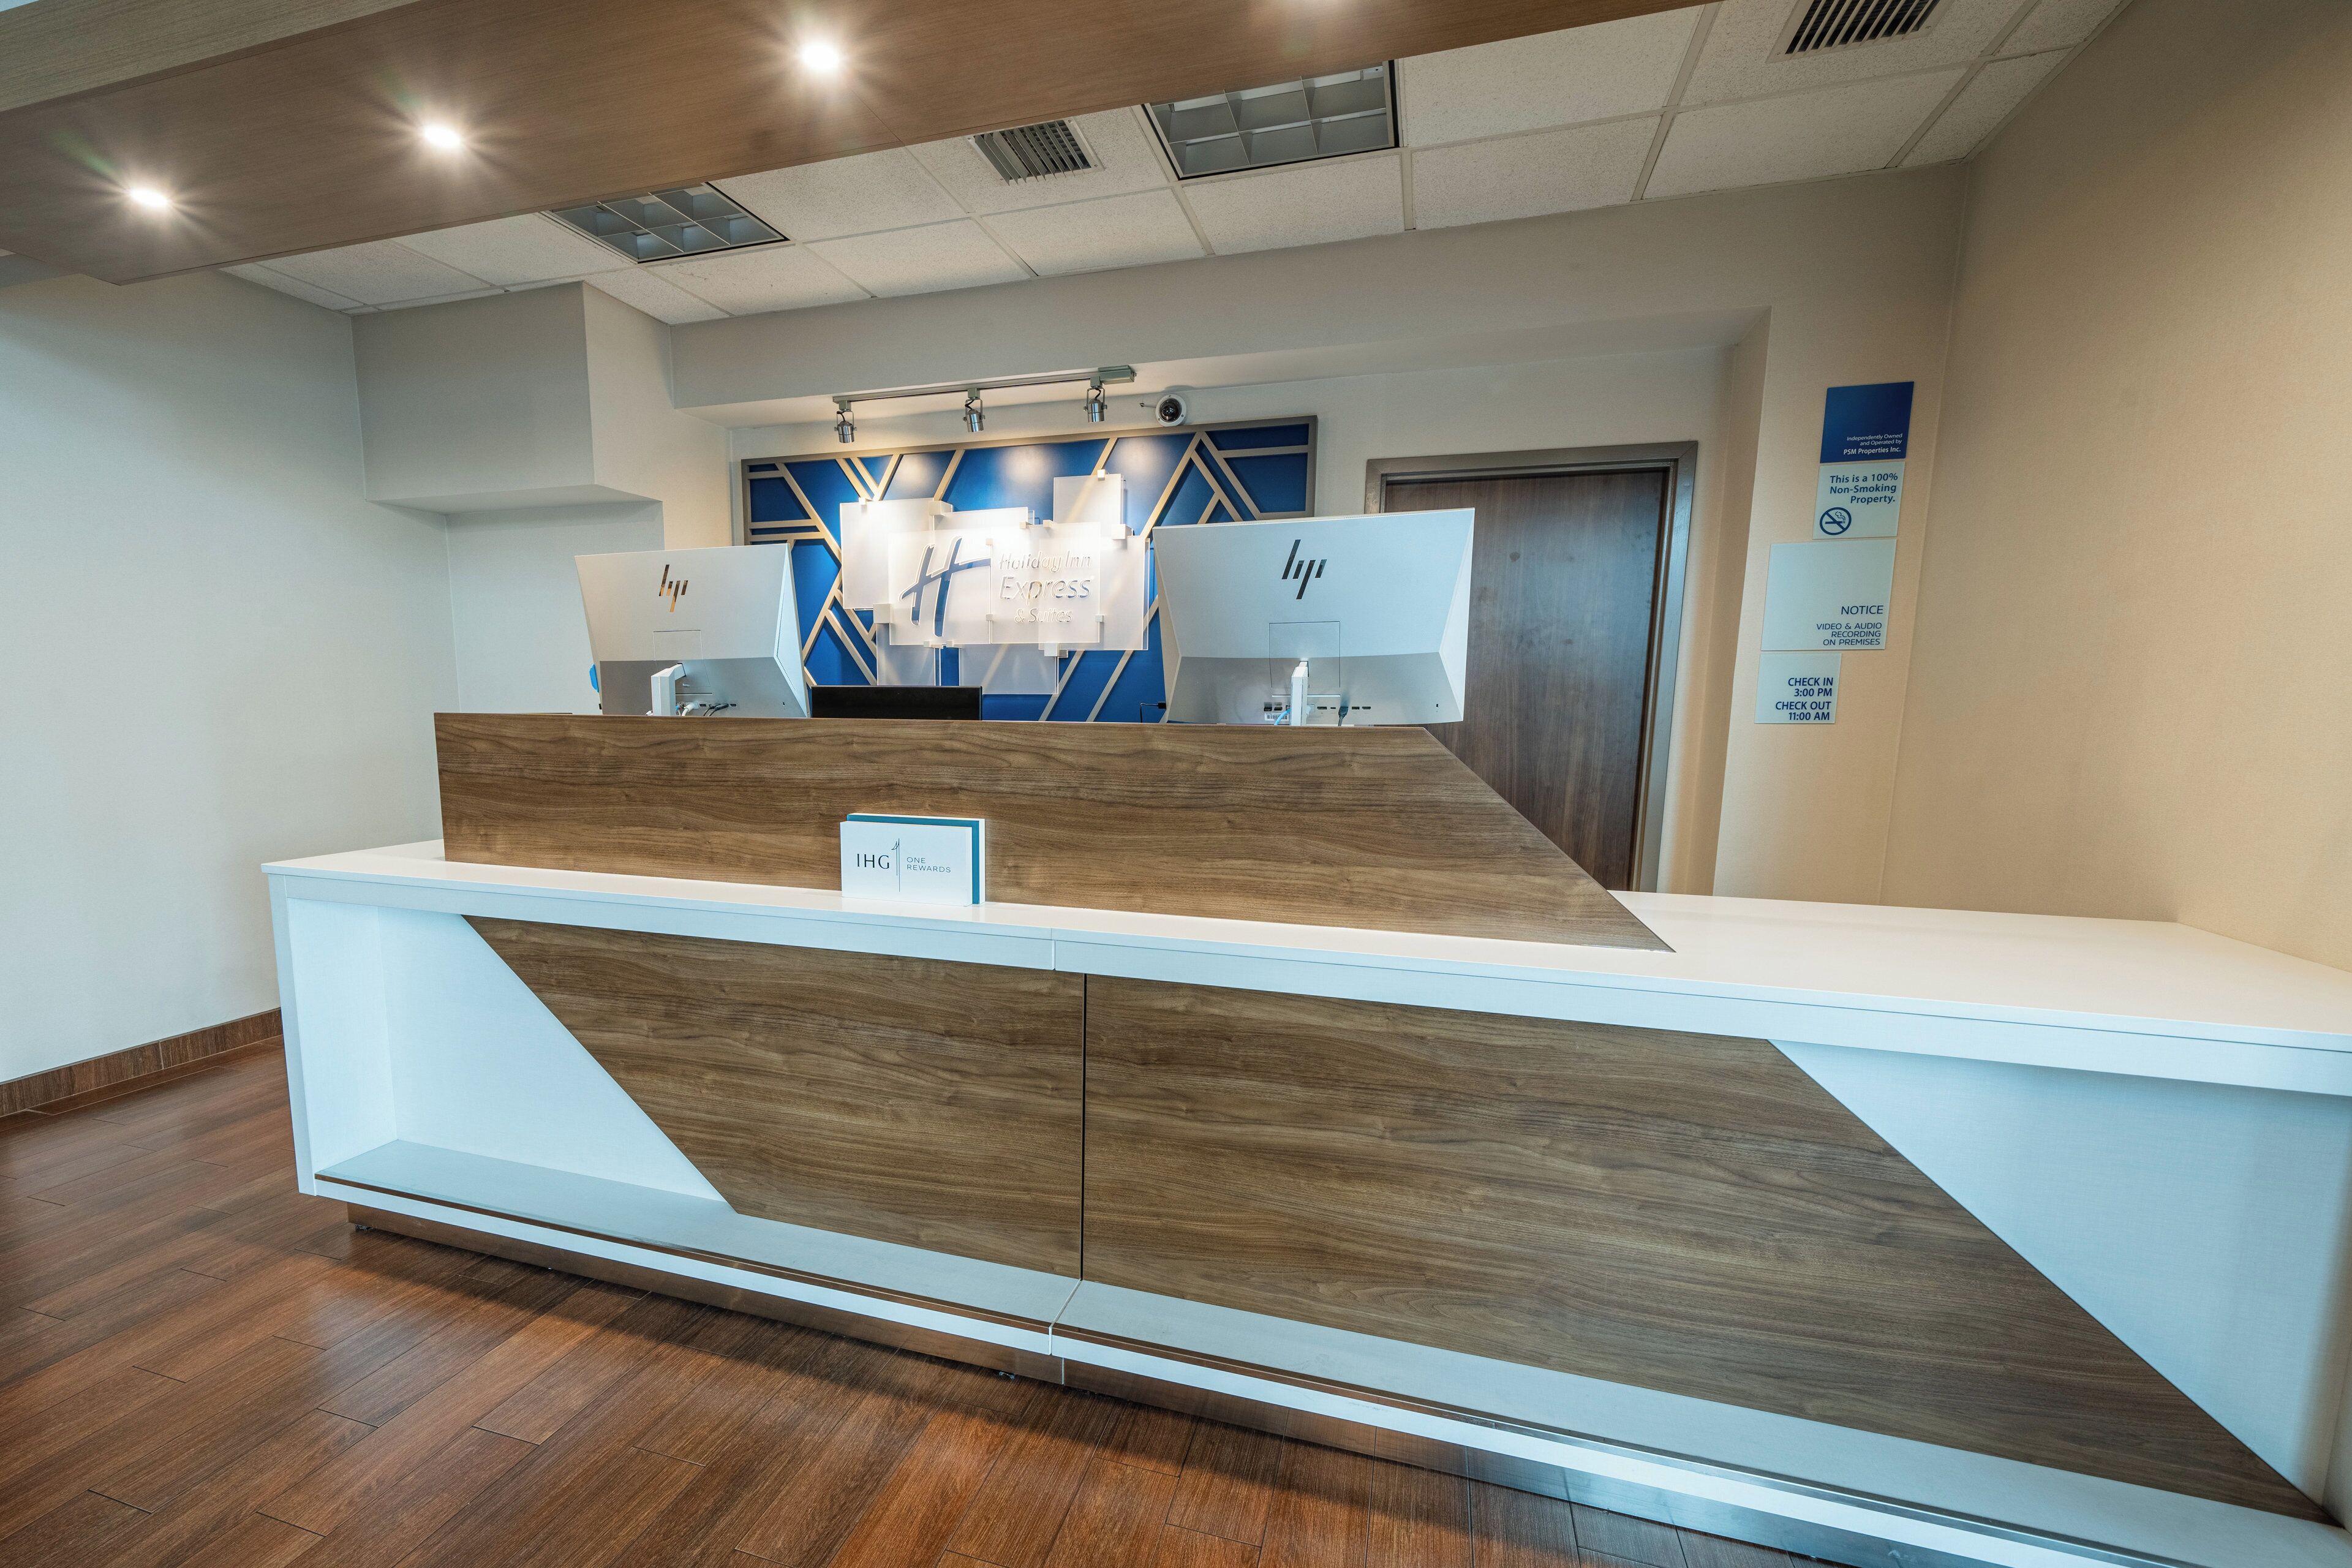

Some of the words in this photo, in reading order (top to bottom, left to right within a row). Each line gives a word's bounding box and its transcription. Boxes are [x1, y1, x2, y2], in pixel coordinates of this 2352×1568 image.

[1858, 447, 1889, 455] Properties
[1830, 475, 1849, 483] This
[1852, 474, 1860, 483] is
[1871, 473, 1898, 482] 100%
[1830, 483, 1897, 494] Non-Smoking
[1850, 495, 1896, 505] Property.
[998, 550, 1063, 573] Holiday
[1064, 550, 1093, 569] Inn
[999, 575, 1093, 606] Express
[1014, 608, 1025, 623] &
[1028, 607, 1073, 623] Suites
[1841, 605, 1884, 615] NOTICE
[1787, 677, 1820, 687] CHECK
[1823, 677, 1834, 686] IN
[1794, 688, 1815, 697] 3:00
[1817, 688, 1833, 697] PM
[1775, 701, 1807, 710] CHECK
[1809, 701, 1832, 710] OUT
[1788, 712, 1811, 721] 11:00
[1813, 712, 1830, 721] AM
[856, 853, 890, 870] IHG
[907, 864, 951, 873] REWARDS
